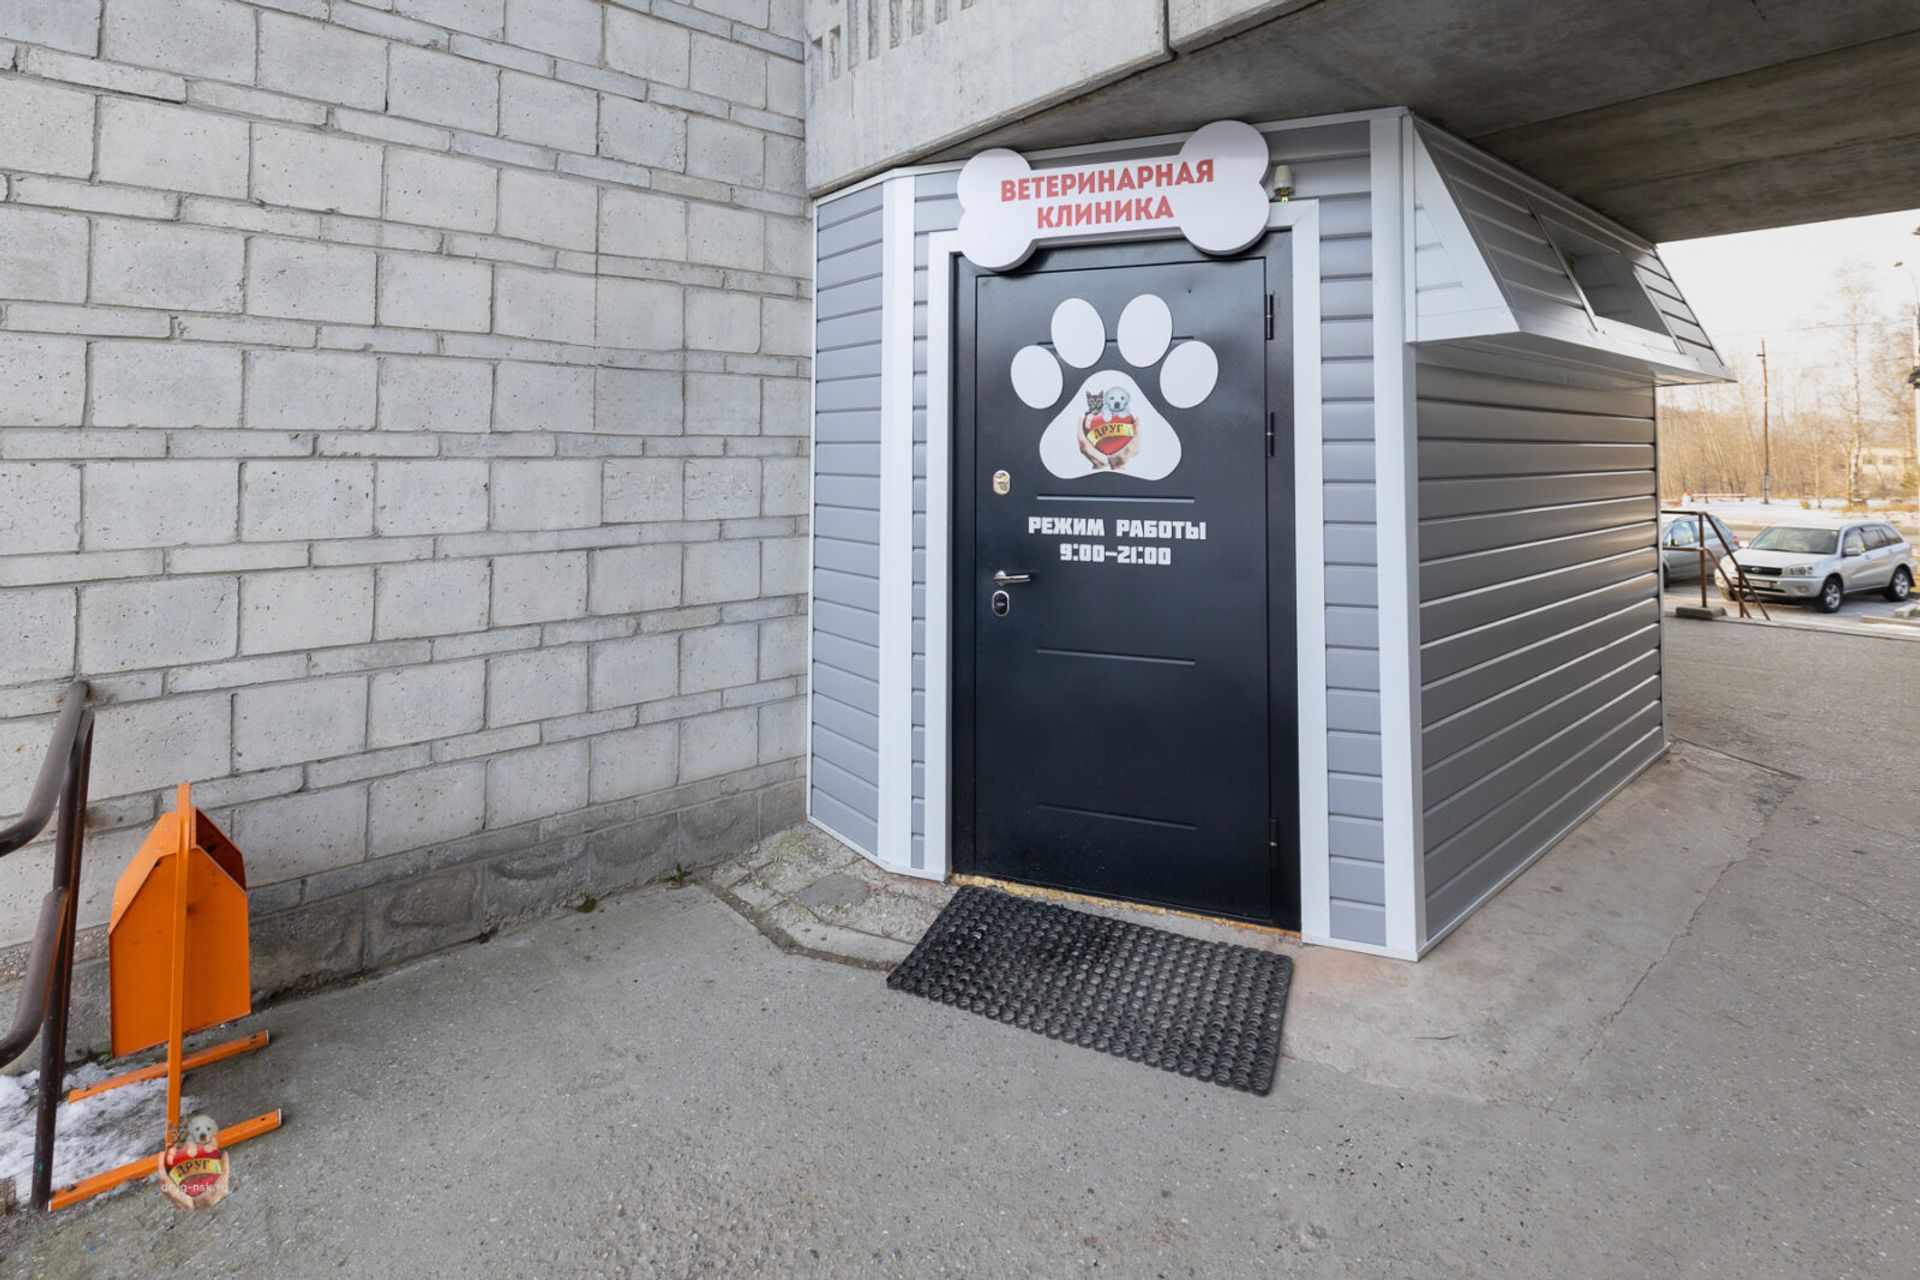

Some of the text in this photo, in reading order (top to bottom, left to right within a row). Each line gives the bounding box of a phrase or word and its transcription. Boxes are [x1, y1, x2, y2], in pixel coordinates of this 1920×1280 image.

[1001, 159, 1214, 202] ВЕТЕРИНАРНАЯ
[1037, 195, 1174, 229] КЛИНИКА
[1028, 516, 1206, 540] РЕЖИМ РАБОТЫ
